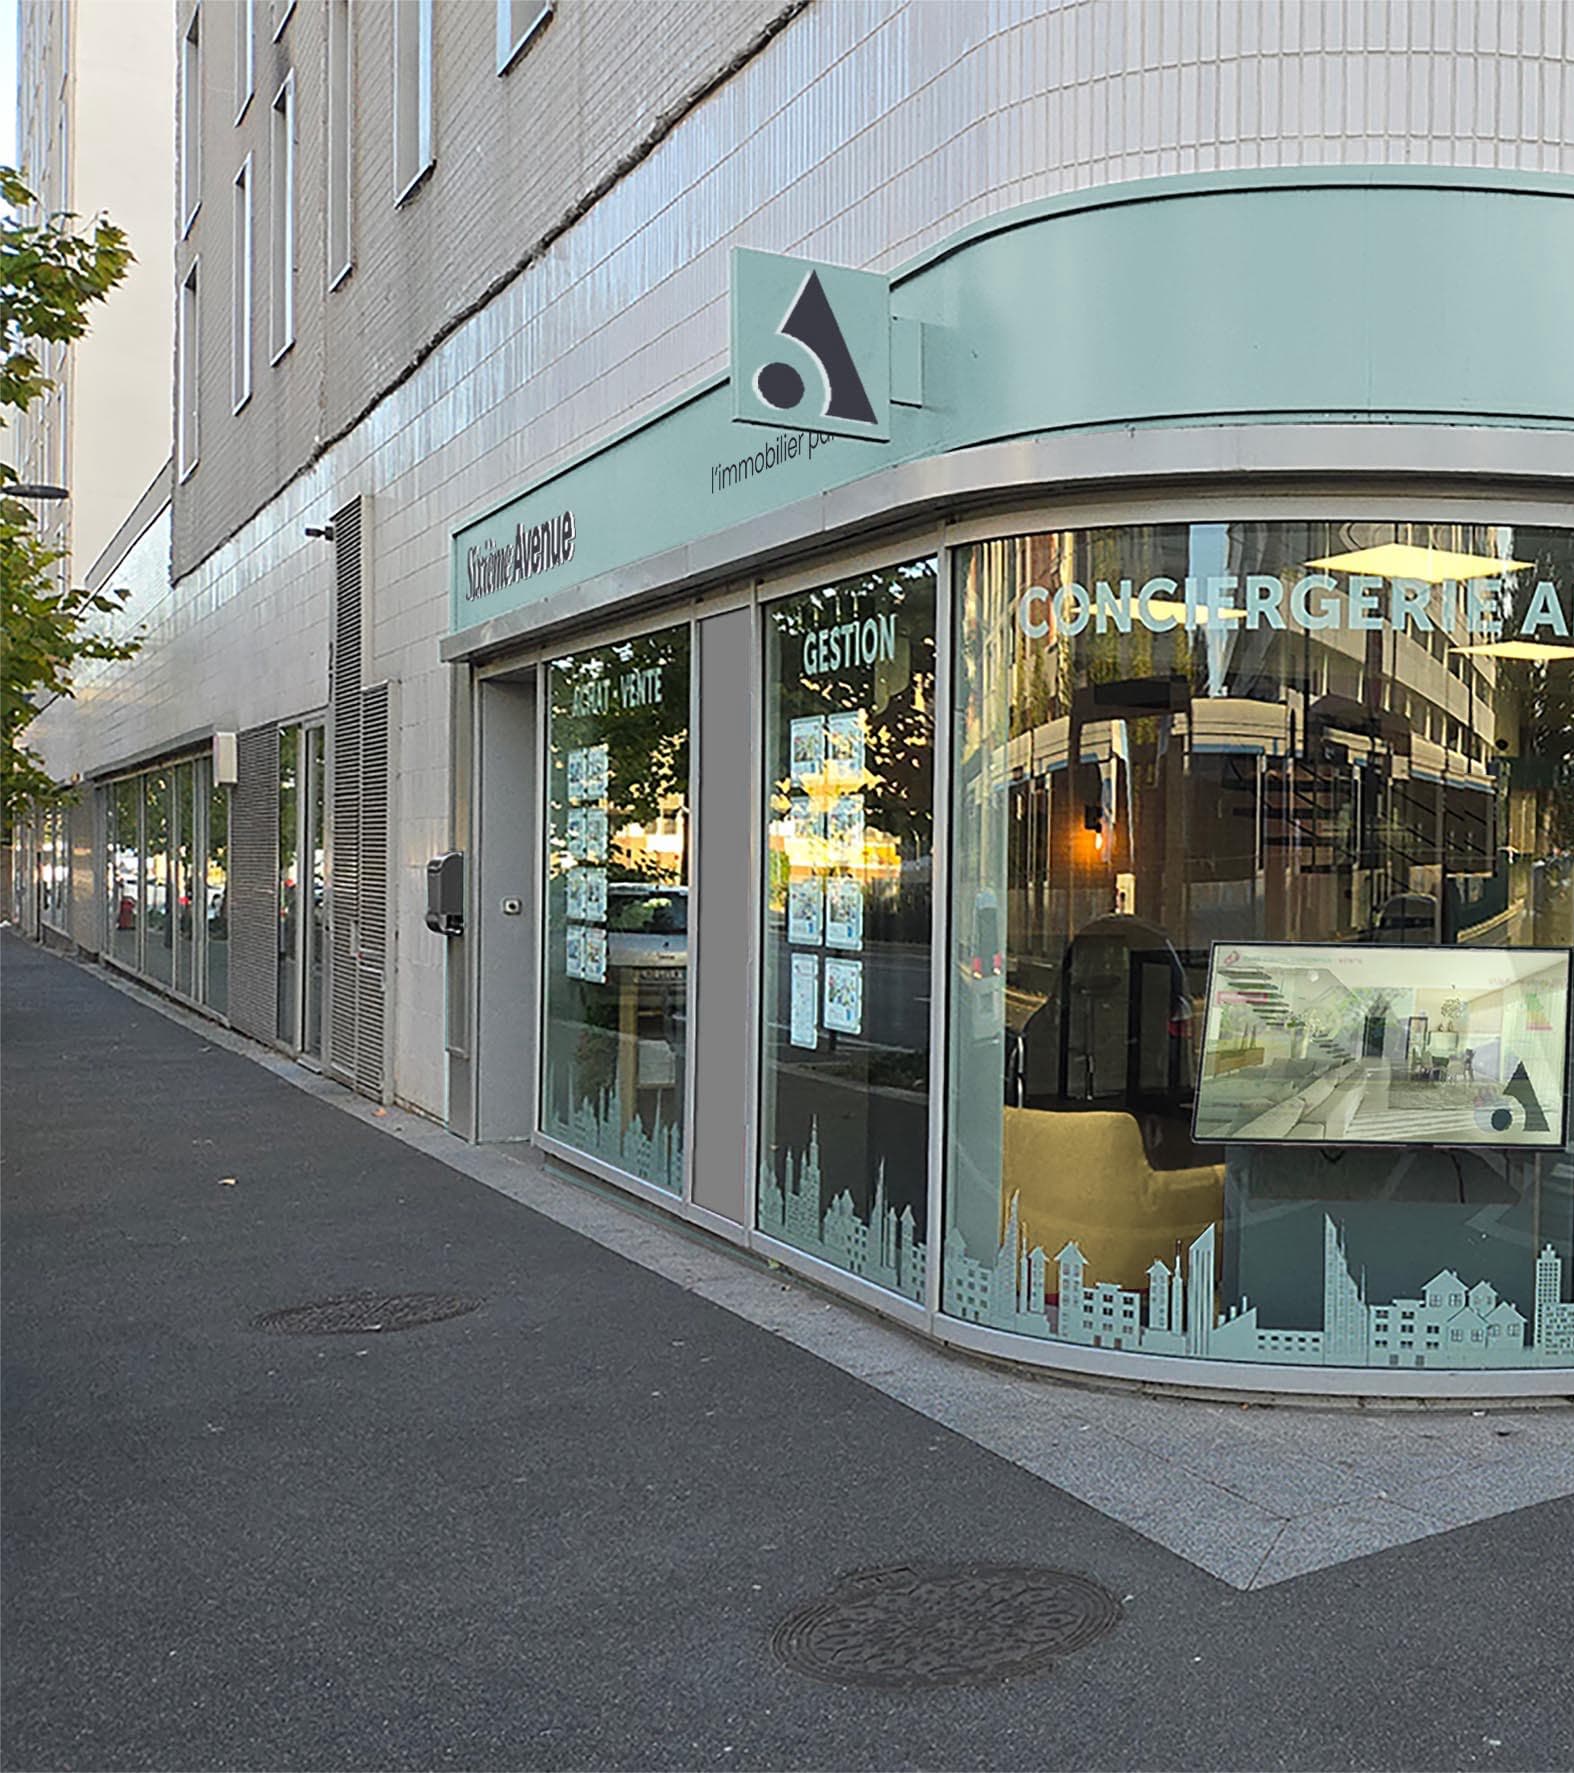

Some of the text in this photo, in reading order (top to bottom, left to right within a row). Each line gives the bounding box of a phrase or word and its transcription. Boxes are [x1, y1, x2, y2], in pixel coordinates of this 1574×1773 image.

[711, 432, 804, 494] l'immobilier
[513, 511, 576, 583] Avenue
[1019, 574, 1503, 639] CONCIERGERIE
[803, 613, 898, 676] GESTION
